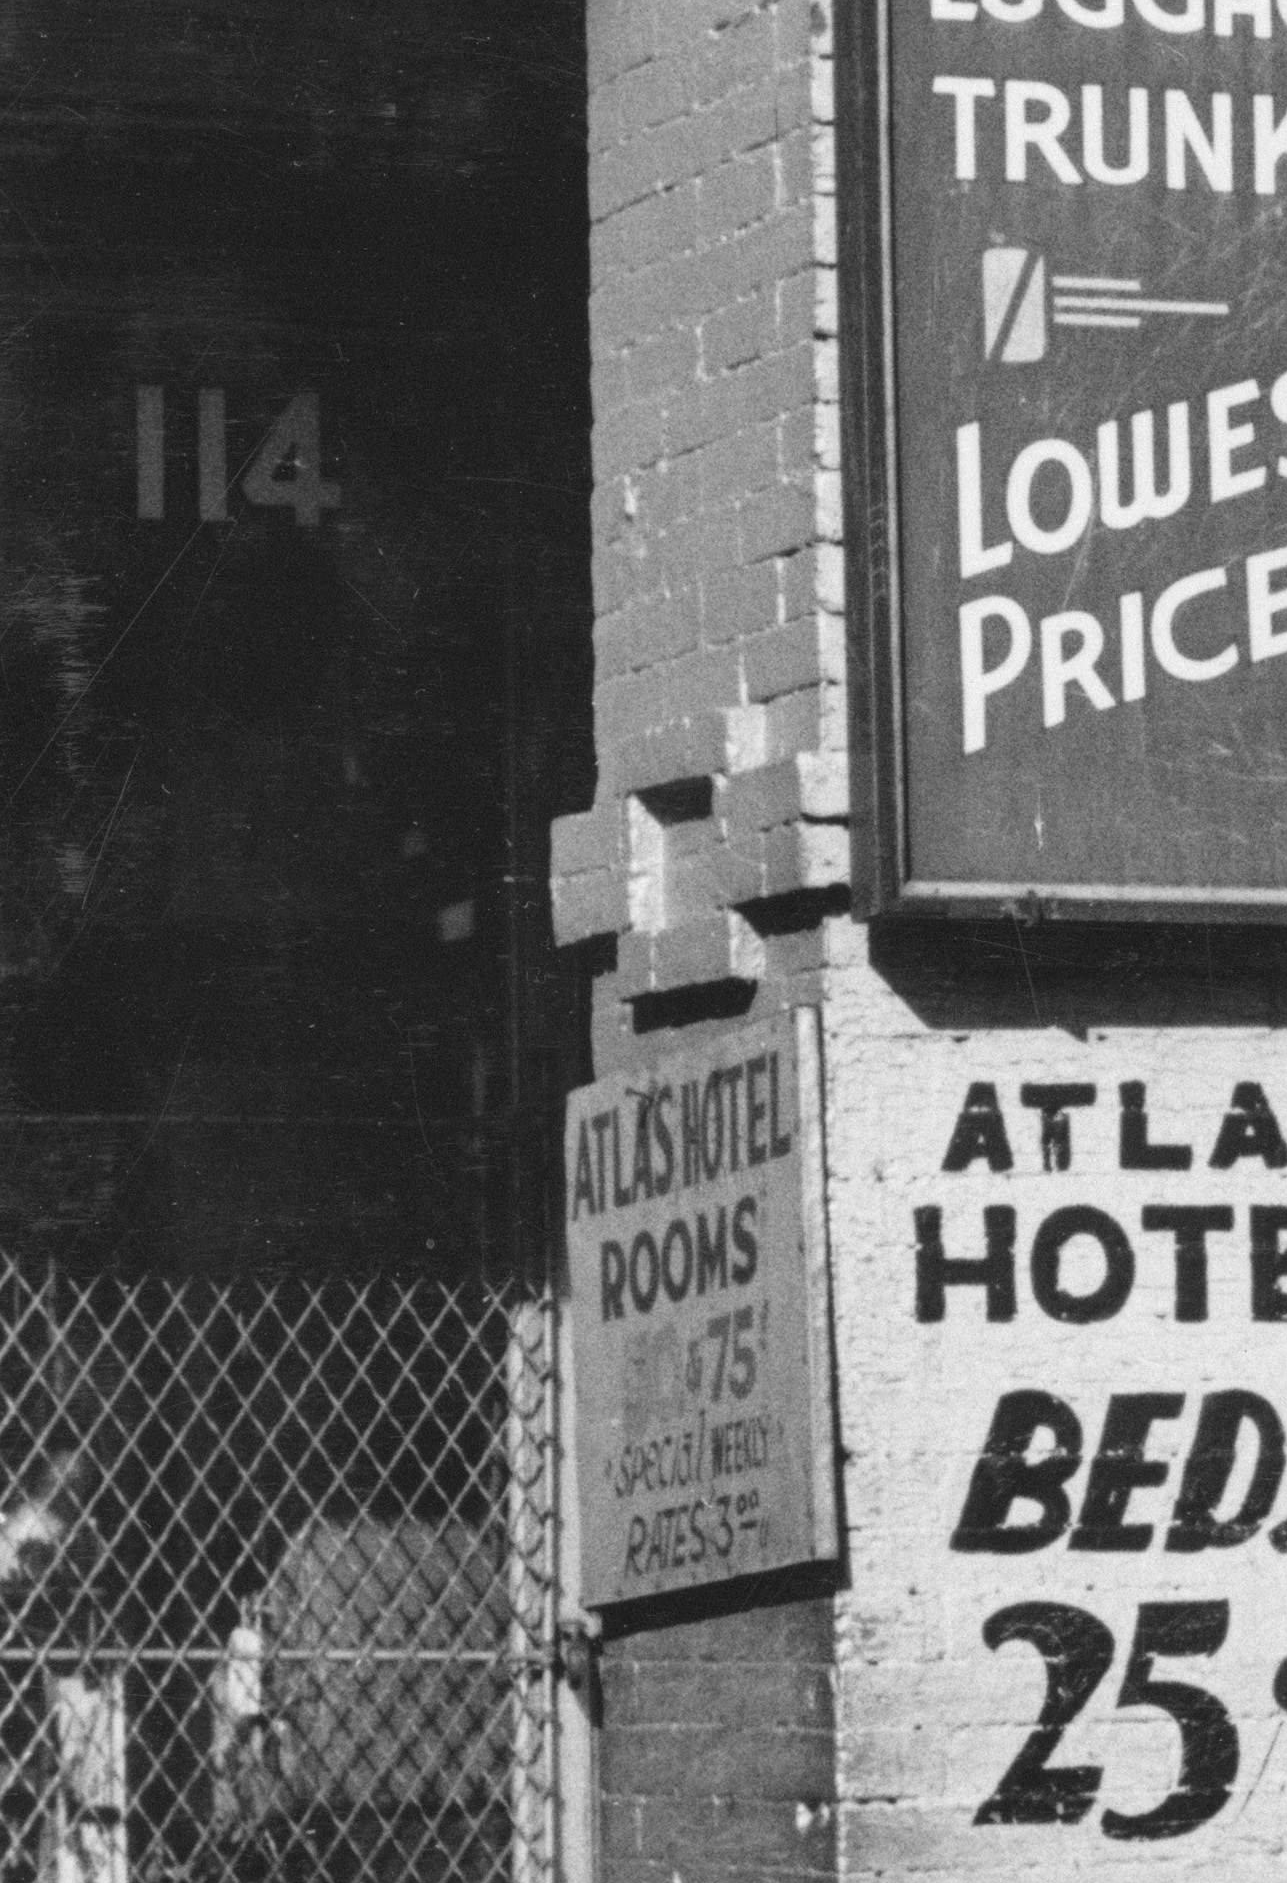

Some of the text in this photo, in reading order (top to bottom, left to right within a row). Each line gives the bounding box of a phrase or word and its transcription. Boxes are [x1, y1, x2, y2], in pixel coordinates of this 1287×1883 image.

[136, 384, 342, 525] 114
[572, 1050, 792, 1223] ATLAS HOTEL
[602, 1195, 758, 1323] ROOMS
